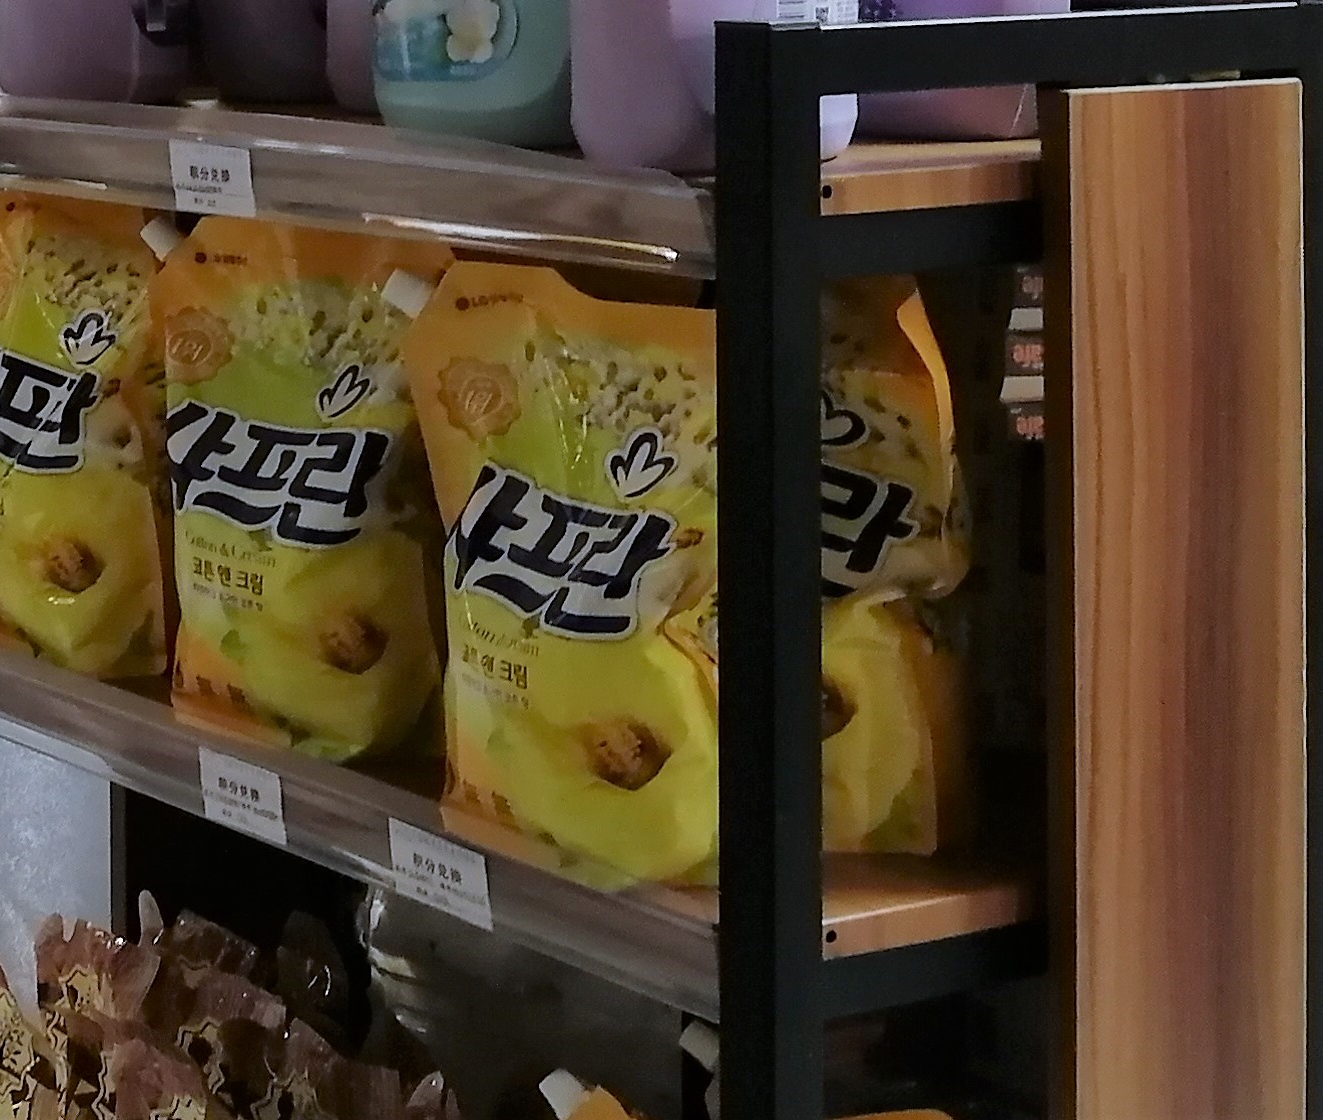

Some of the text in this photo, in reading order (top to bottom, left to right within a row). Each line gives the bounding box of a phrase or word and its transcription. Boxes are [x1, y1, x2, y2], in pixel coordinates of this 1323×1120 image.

[166, 401, 390, 545] 샤프란
[236, 570, 264, 596] 크림
[445, 465, 673, 634] 샤프란
[499, 659, 528, 690] 크림
